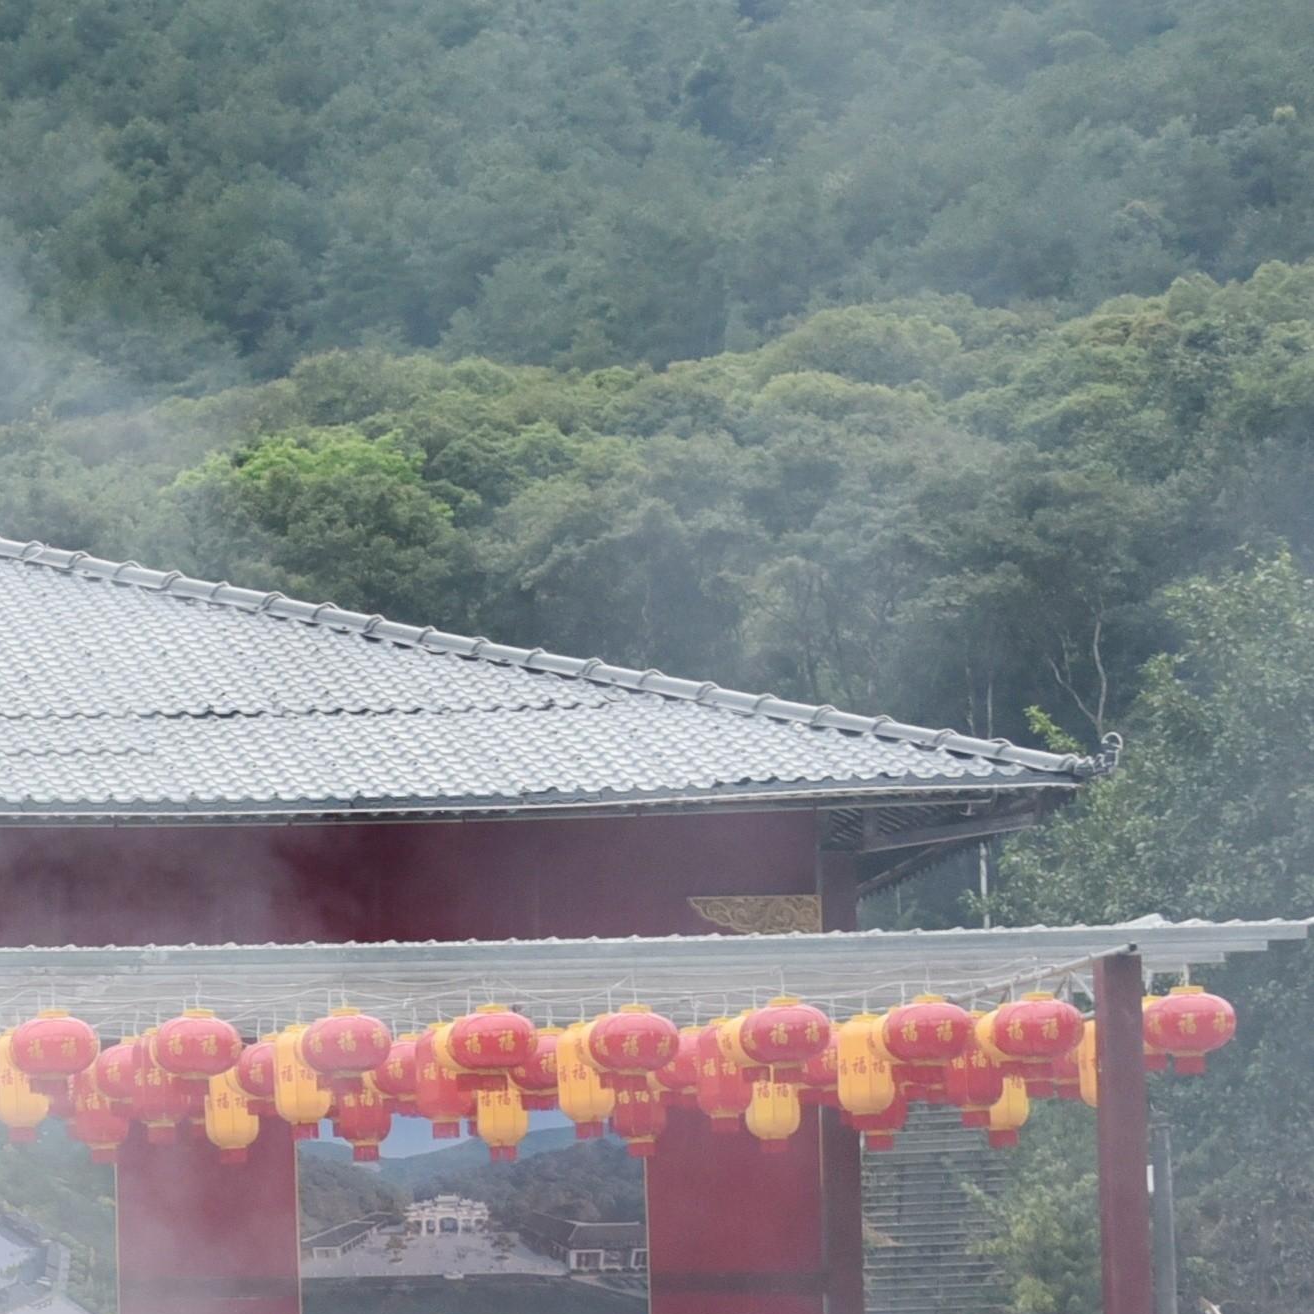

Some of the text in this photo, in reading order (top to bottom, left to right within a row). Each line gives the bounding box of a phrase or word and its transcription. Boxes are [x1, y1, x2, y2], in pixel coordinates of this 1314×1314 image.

[769, 1022, 788, 1045] 福
[806, 1021, 820, 1043] 福
[902, 1020, 918, 1042] 福
[937, 1020, 953, 1042] 福
[1009, 1019, 1025, 1041] 福
[1042, 1017, 1059, 1041] 福
[1179, 1012, 1198, 1034] 福
[1213, 1012, 1227, 1034] 福
[28, 1038, 43, 1057] 福
[61, 1036, 77, 1057] 福
[169, 1034, 183, 1056] 福
[202, 1034, 218, 1056] 福
[309, 1034, 322, 1054] 福
[337, 1031, 356, 1052] 福
[465, 1032, 481, 1054] 福
[498, 1030, 516, 1052] 福
[595, 1035, 609, 1057] 福
[622, 1034, 639, 1057] 福
[658, 1035, 670, 1056] 福
[744, 1030, 756, 1050] 福
[107, 1061, 121, 1082] 福
[250, 1064, 264, 1084] 福
[281, 1064, 293, 1083] 福
[387, 1057, 404, 1080] 福
[423, 1063, 438, 1081] 福
[573, 1064, 587, 1082] 福
[703, 1059, 716, 1077] 福
[723, 1059, 738, 1077] 福
[853, 1056, 867, 1075] 福
[0, 1067, 13, 1086] 福
[147, 1068, 161, 1086] 福
[217, 1093, 229, 1109] 福
